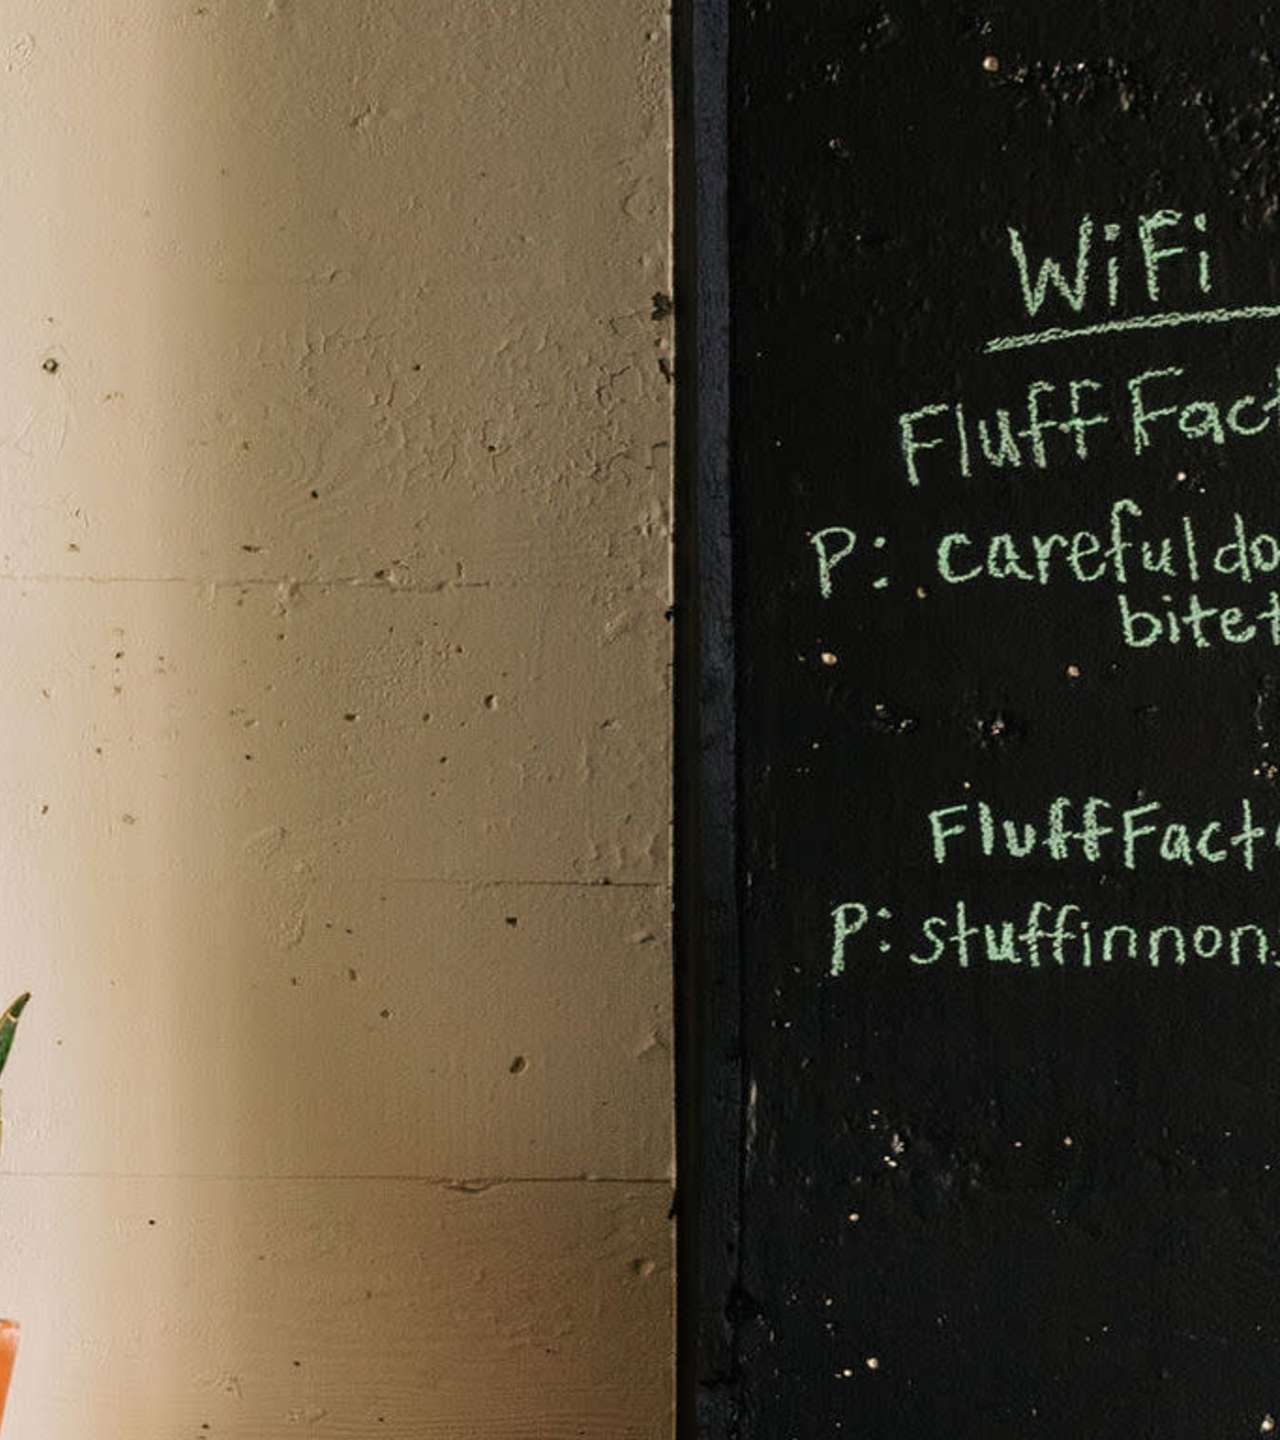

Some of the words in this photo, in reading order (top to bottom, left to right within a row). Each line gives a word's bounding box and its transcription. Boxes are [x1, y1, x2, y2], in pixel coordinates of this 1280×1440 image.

[1007, 209, 1212, 317] WiFi
[810, 526, 889, 599] P:
[927, 796, 1280, 872] FluffFact
[910, 900, 1280, 968] stuffinnon
